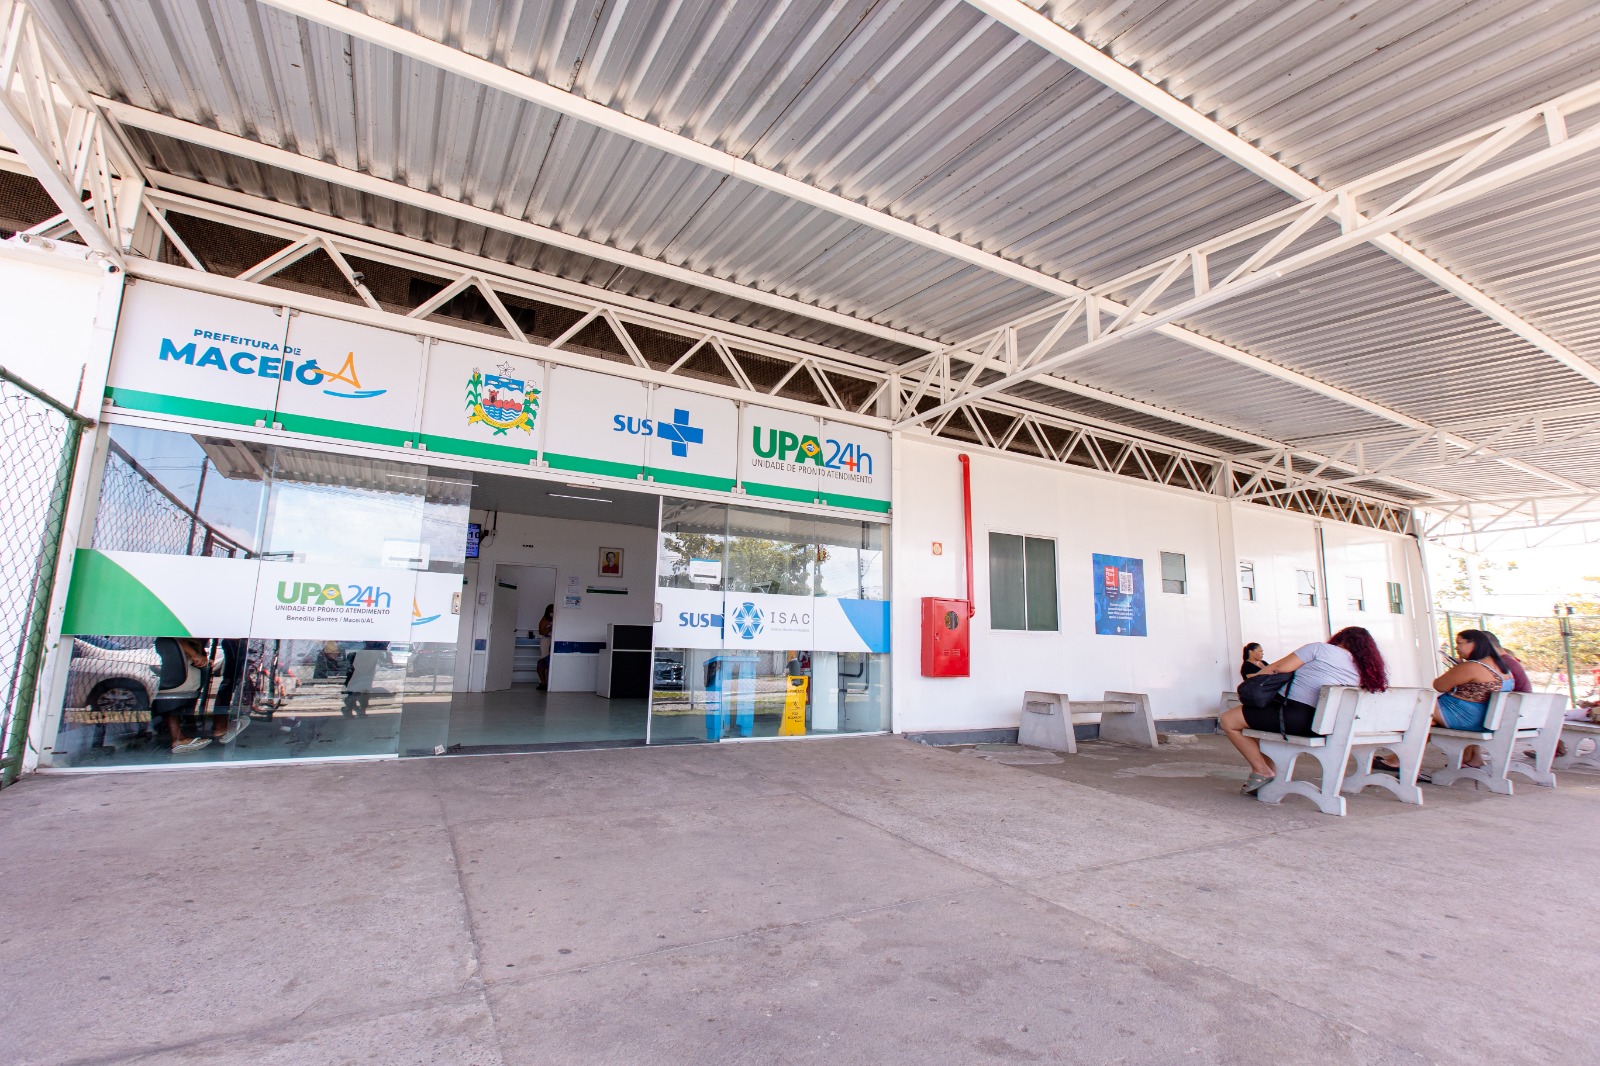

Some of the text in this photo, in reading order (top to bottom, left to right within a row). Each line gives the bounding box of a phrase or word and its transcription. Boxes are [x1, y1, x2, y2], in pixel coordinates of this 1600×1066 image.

[193, 328, 301, 355] PREFEITURA DE
[158, 338, 324, 386] MACEIÓ
[613, 414, 653, 436] SUS
[751, 458, 873, 485] UNIDADE DE PRONTO ATENDIMENTO
[286, 614, 315, 622] Benedito
[316, 615, 338, 623] Bentes
[317, 606, 344, 614] PRONTO
[345, 607, 391, 615] ATENDIMENTO
[679, 612, 709, 628] SUS
[770, 611, 811, 625] ISAC
